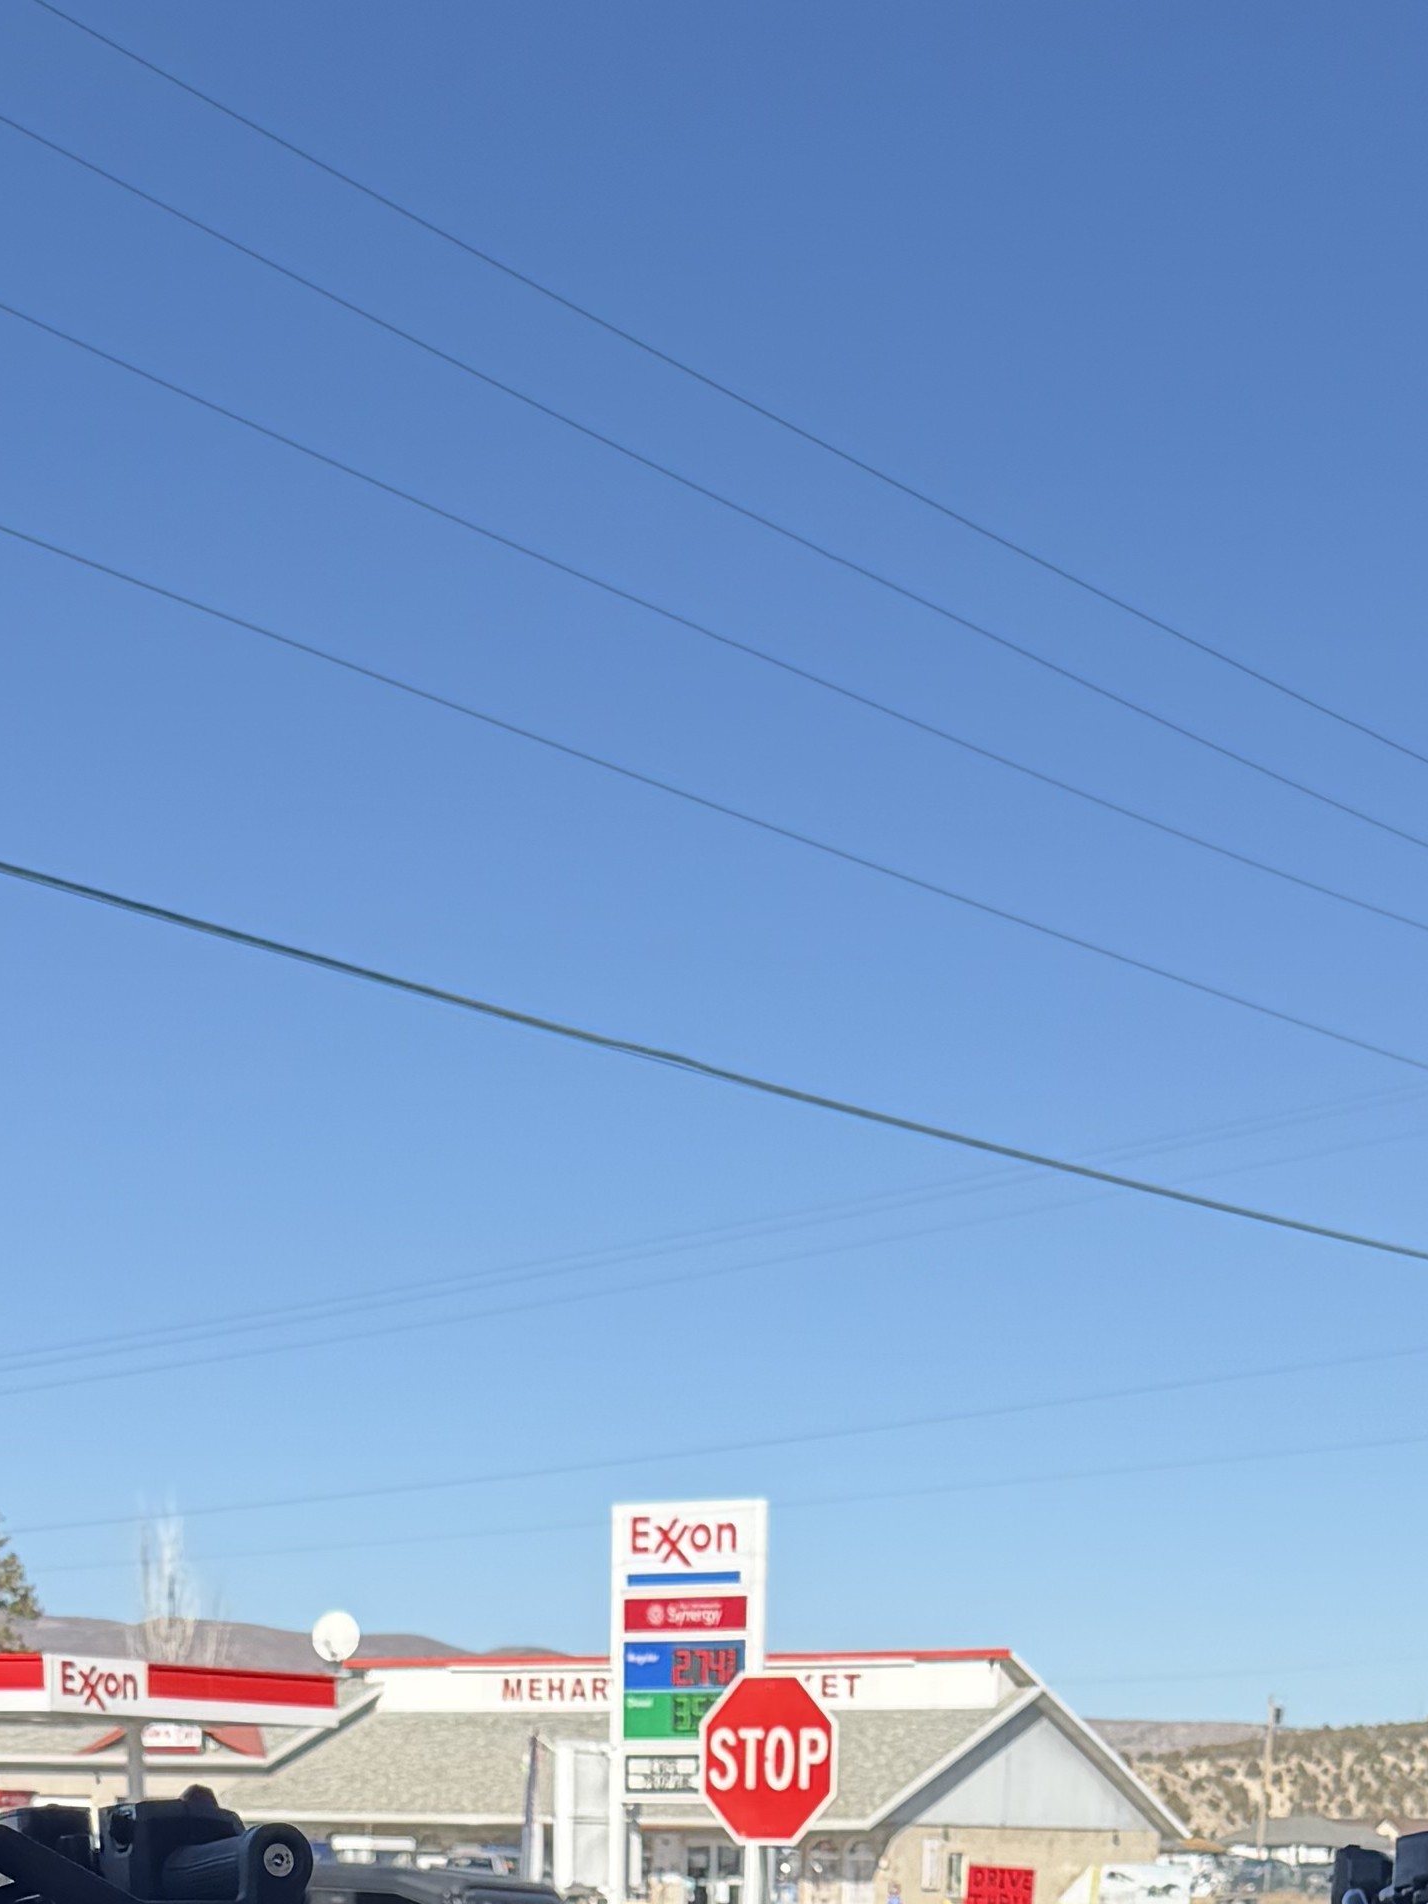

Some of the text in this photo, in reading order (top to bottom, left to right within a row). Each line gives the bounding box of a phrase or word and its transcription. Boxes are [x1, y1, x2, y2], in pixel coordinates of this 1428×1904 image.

[631, 1517, 737, 1568] Exxon
[666, 1603, 723, 1627] Synergy
[61, 1661, 138, 1711] Exxon
[709, 1727, 829, 1791] STOP
[973, 1869, 1032, 1890] DRIVE
